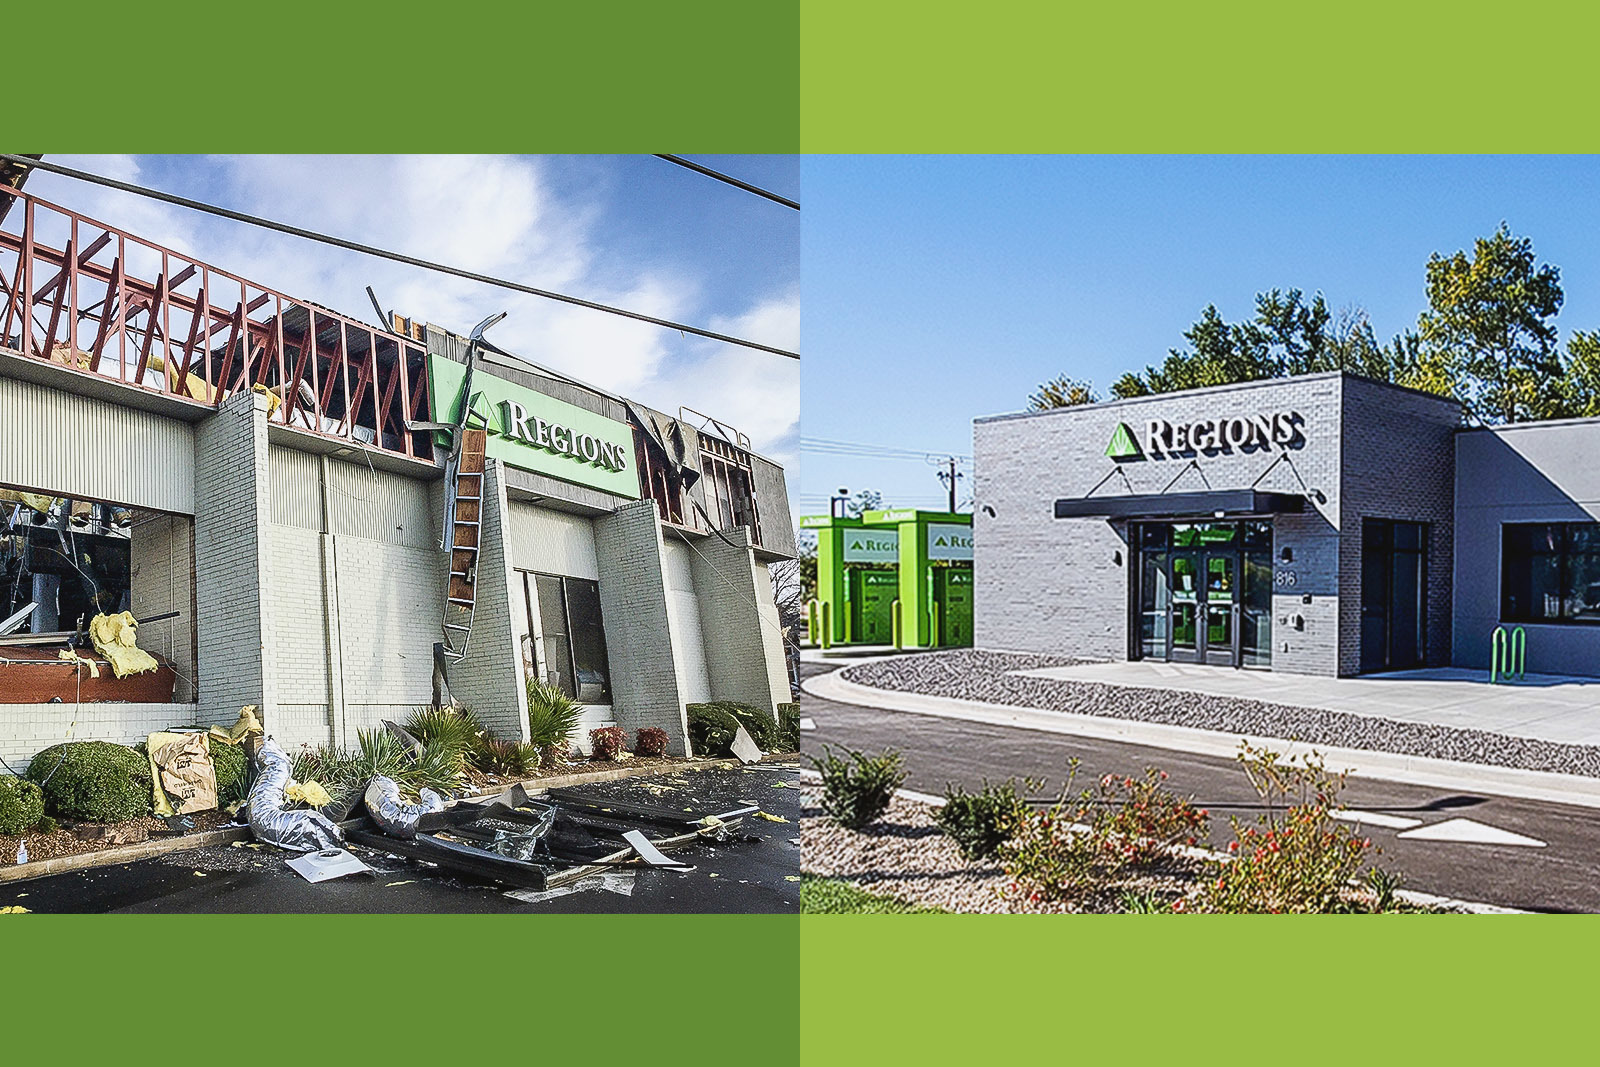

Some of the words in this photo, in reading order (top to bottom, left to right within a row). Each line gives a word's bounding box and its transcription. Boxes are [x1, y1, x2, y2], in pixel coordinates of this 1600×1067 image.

[502, 399, 628, 472] REGIONS
[1144, 410, 1299, 456] REGIONS
[1276, 571, 1295, 586] 816
